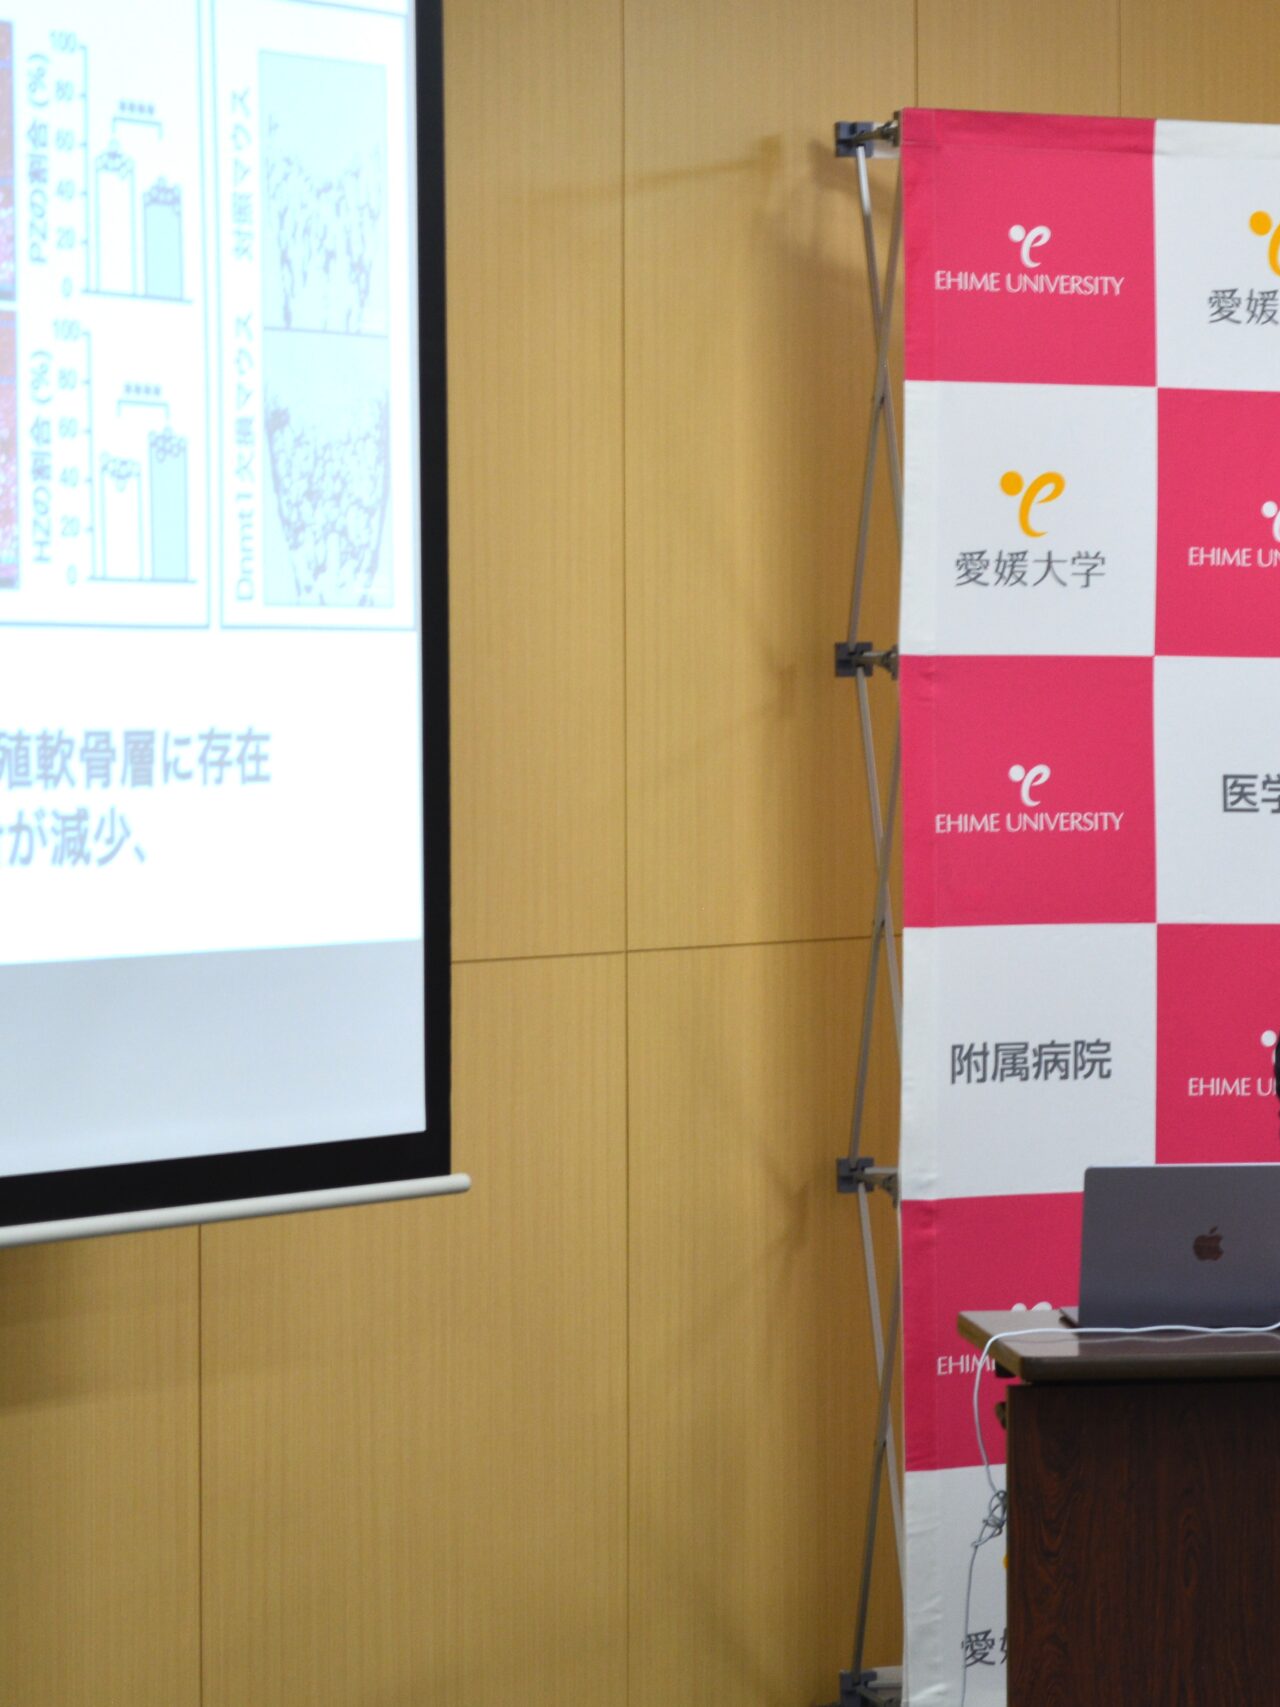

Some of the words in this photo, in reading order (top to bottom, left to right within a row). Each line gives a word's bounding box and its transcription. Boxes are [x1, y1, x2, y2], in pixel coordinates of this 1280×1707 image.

[935, 270, 1000, 292] EHIME
[1006, 273, 1124, 296] UNIVERSITY
[956, 550, 1105, 588] 愛媛大学
[1188, 547, 1251, 567] EHIME
[935, 813, 1000, 833] EHIME
[1006, 812, 1124, 832] UNIVERSITY
[0, 806, 147, 866] が減少、
[951, 1038, 1111, 1084] 附属病院
[1189, 1078, 1251, 1096] EHIME
